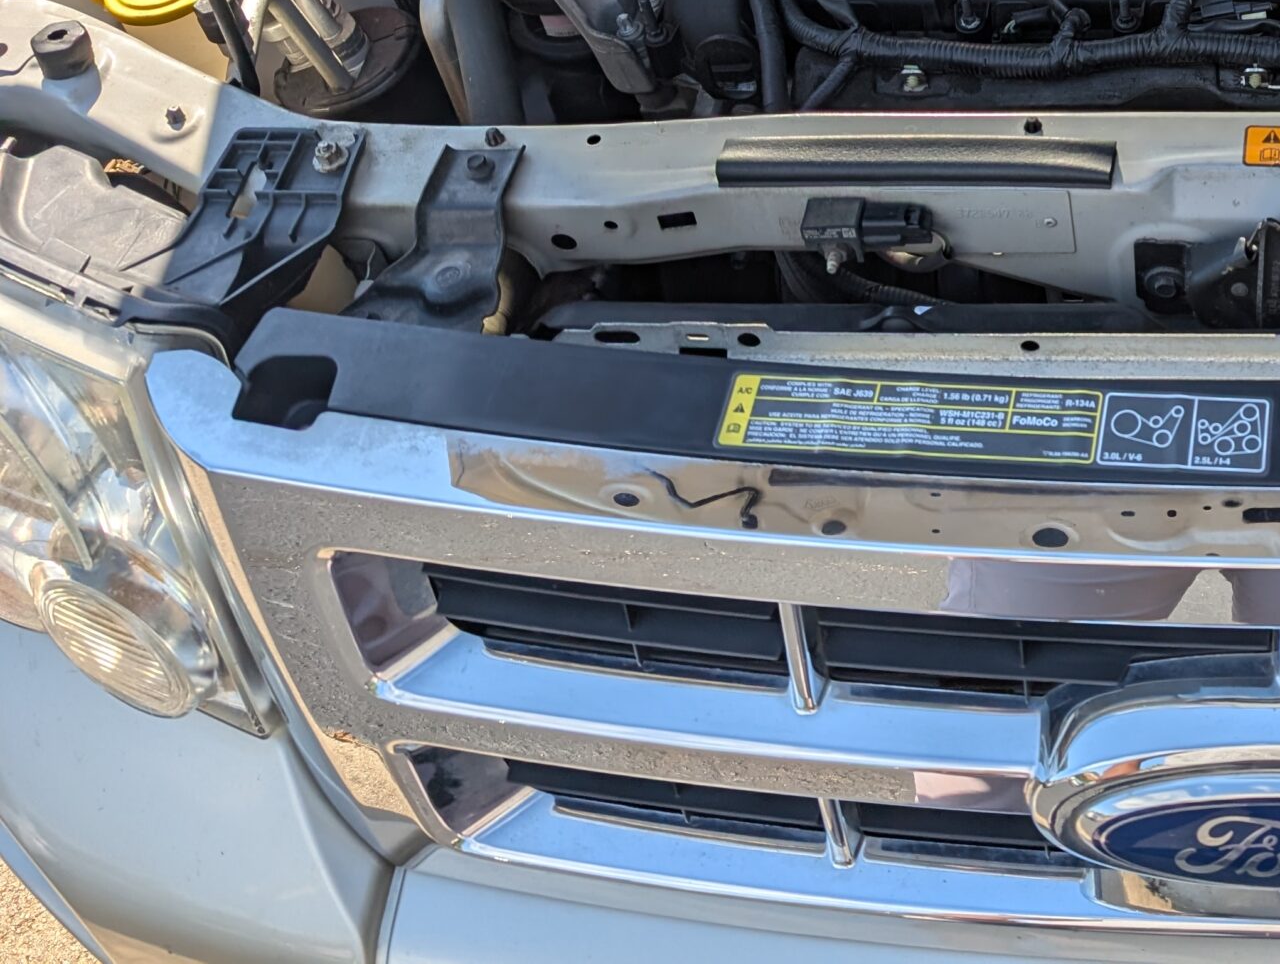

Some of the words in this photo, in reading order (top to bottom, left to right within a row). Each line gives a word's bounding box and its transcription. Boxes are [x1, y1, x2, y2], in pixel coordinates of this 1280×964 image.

[737, 386, 752, 395] A/C
[833, 388, 852, 396] SAE
[852, 389, 874, 398] J639
[962, 393, 970, 401] lb
[994, 394, 1009, 405] kg)
[1065, 399, 1096, 408] R-134A
[1012, 415, 1058, 428] FoMoCo
[1102, 451, 1121, 461] 3.0L
